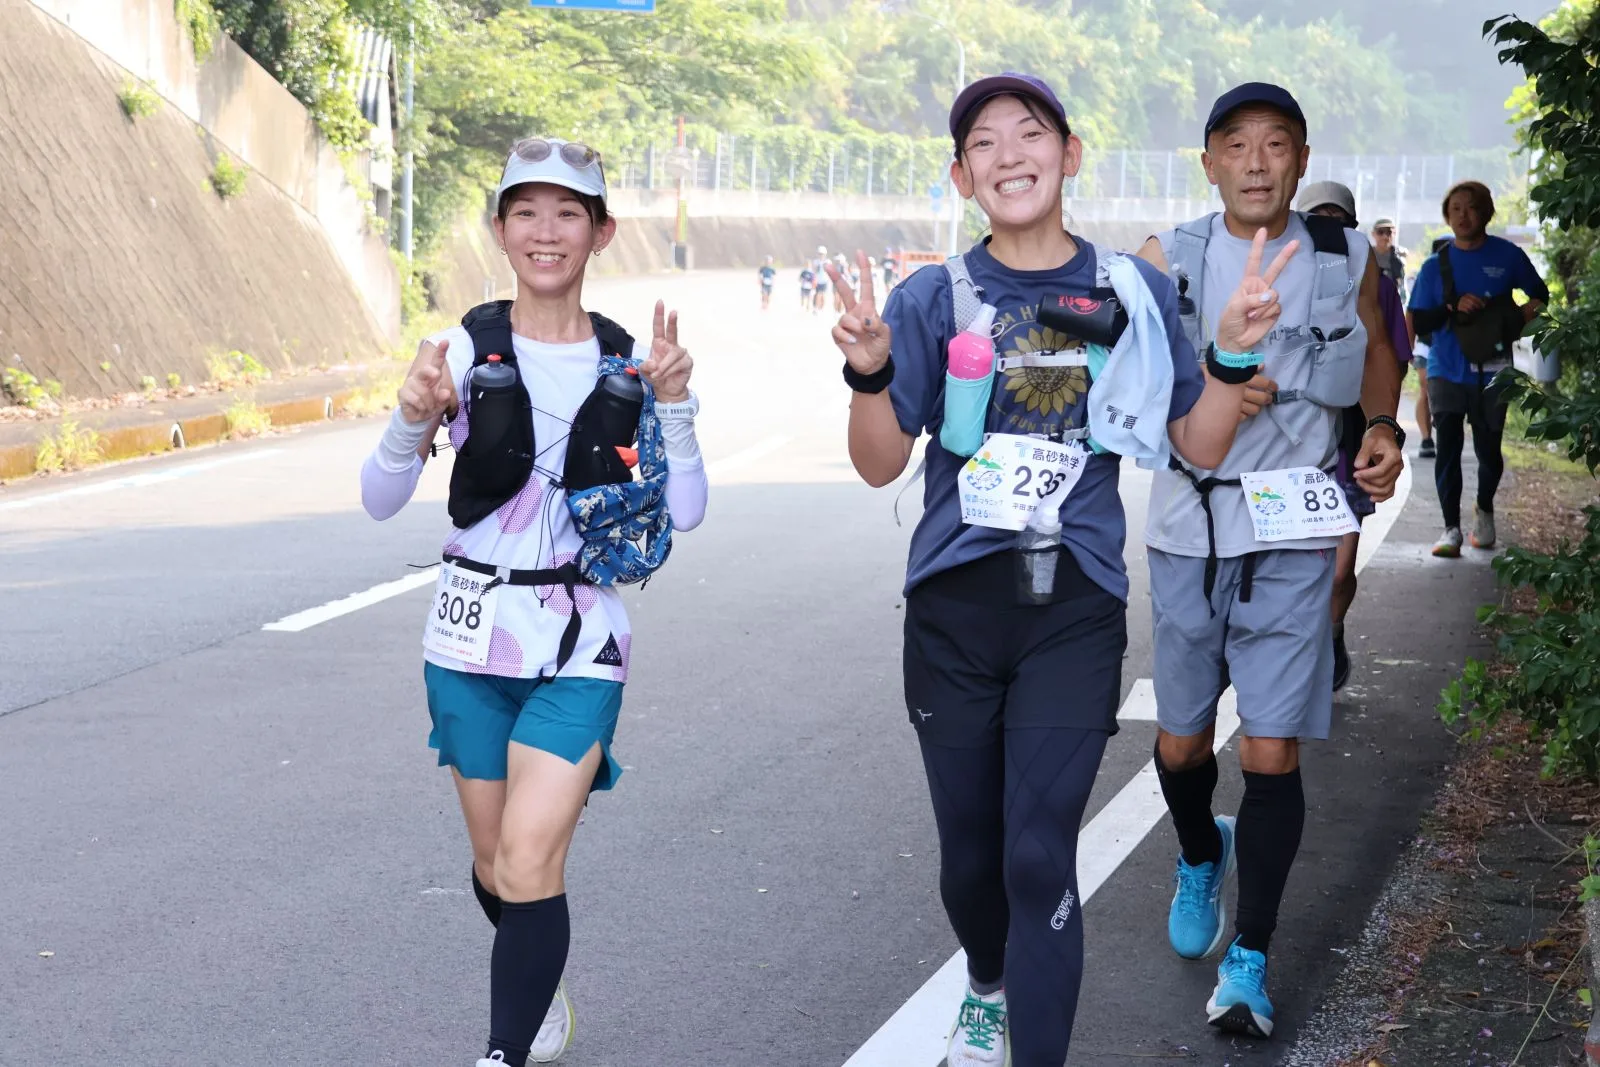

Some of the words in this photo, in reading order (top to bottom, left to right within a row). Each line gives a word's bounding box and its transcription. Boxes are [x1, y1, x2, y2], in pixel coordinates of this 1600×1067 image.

[1009, 414, 1037, 432] RUN
[1042, 415, 1074, 434] TEM
[1032, 447, 1080, 470] 高砂熱学
[1303, 487, 1339, 512] 83
[438, 591, 482, 631] 308
